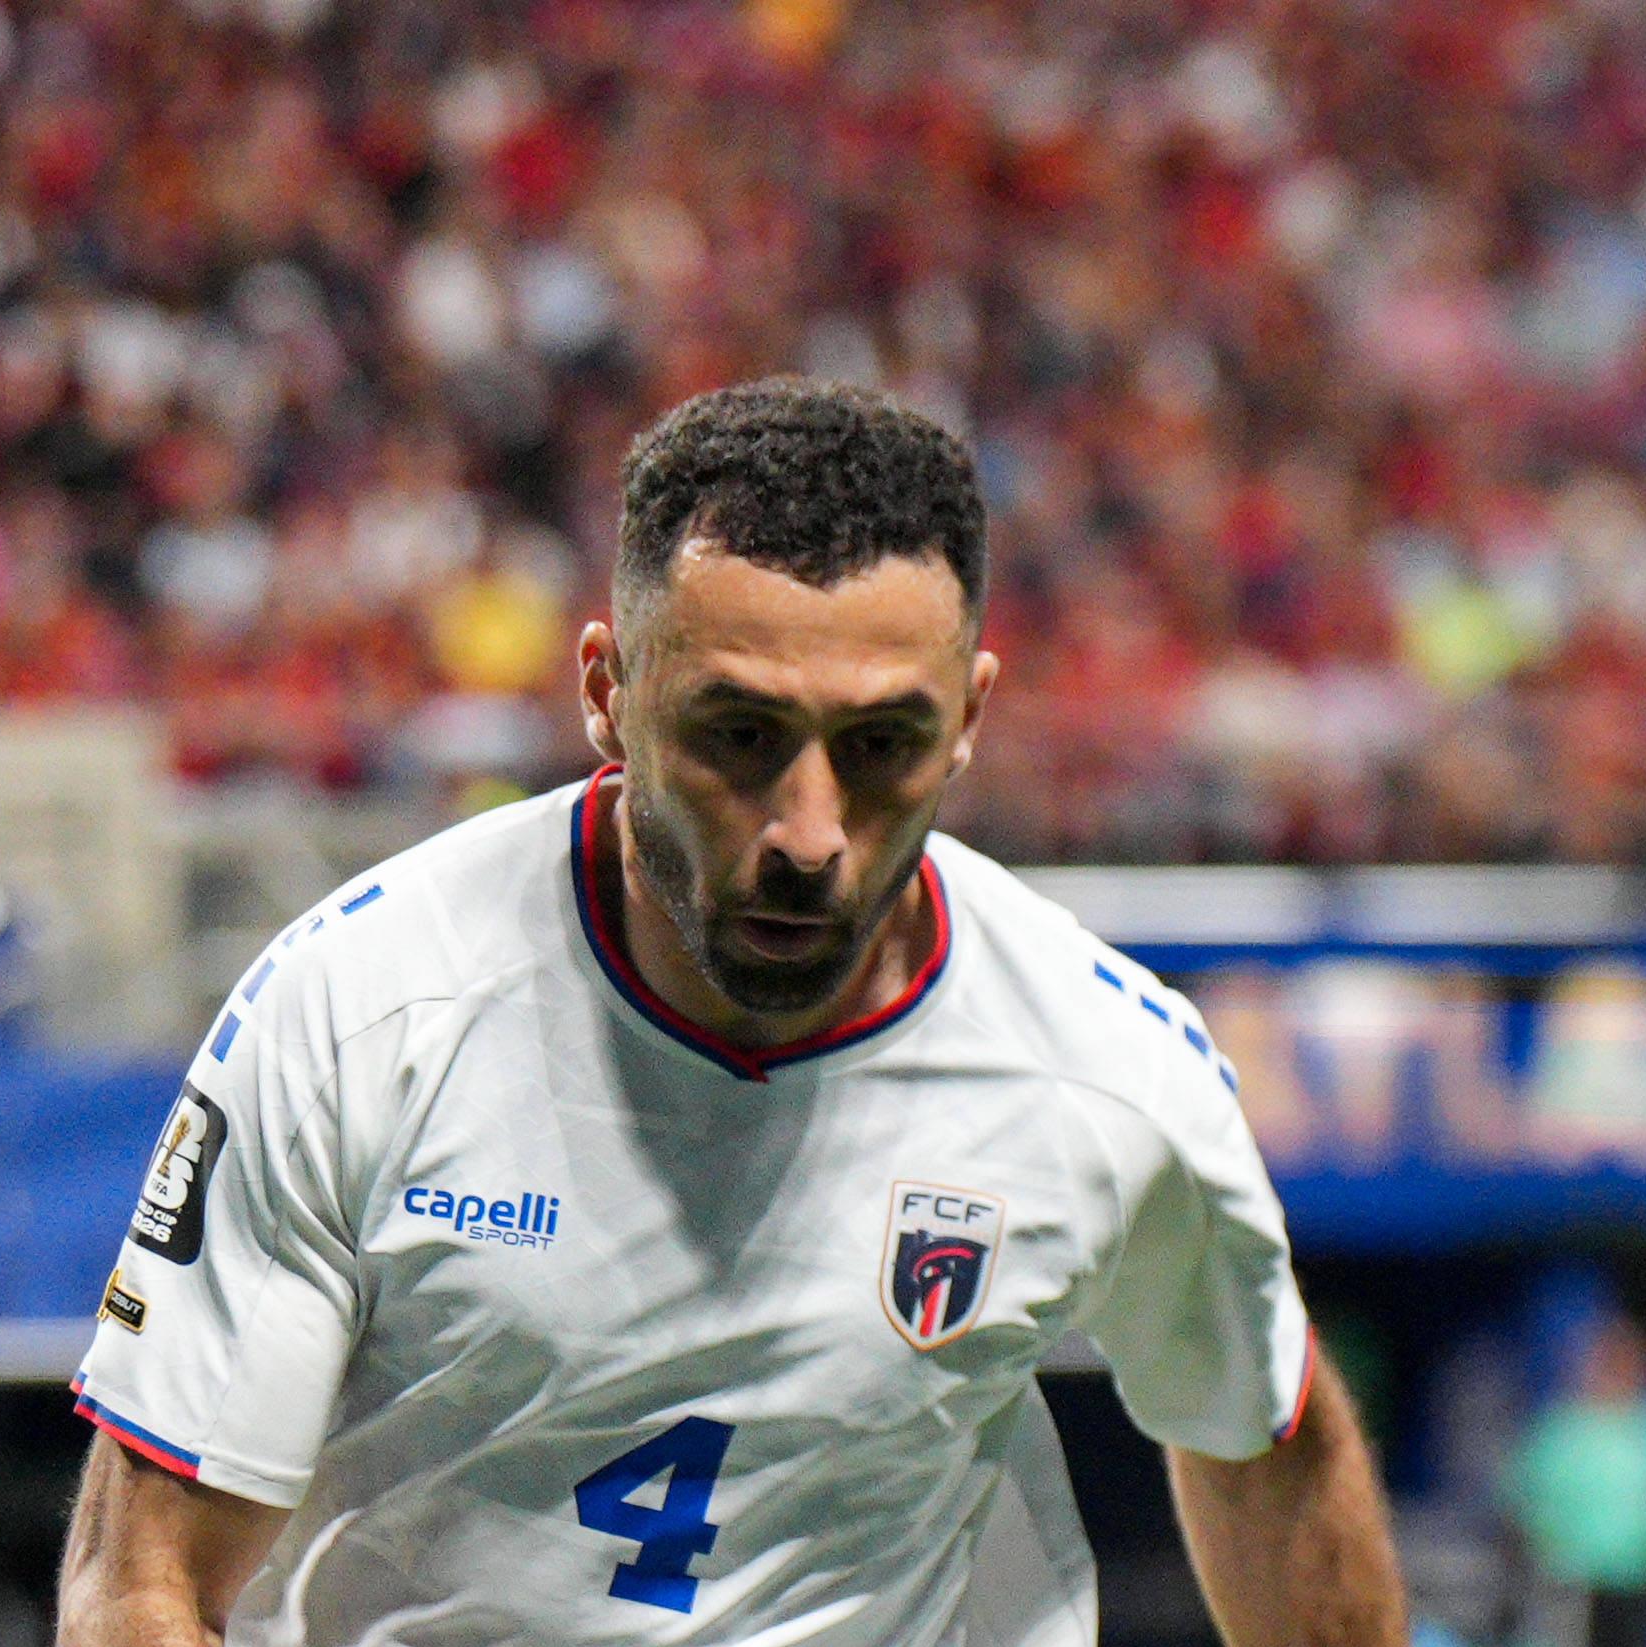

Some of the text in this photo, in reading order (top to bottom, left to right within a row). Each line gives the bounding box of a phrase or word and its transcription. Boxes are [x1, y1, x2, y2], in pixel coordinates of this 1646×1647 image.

[404, 1187, 560, 1234] capelli
[903, 1193, 994, 1224] FCF
[132, 1210, 172, 1244] 026
[468, 1226, 555, 1250] SPORT
[574, 1416, 737, 1614] 4
